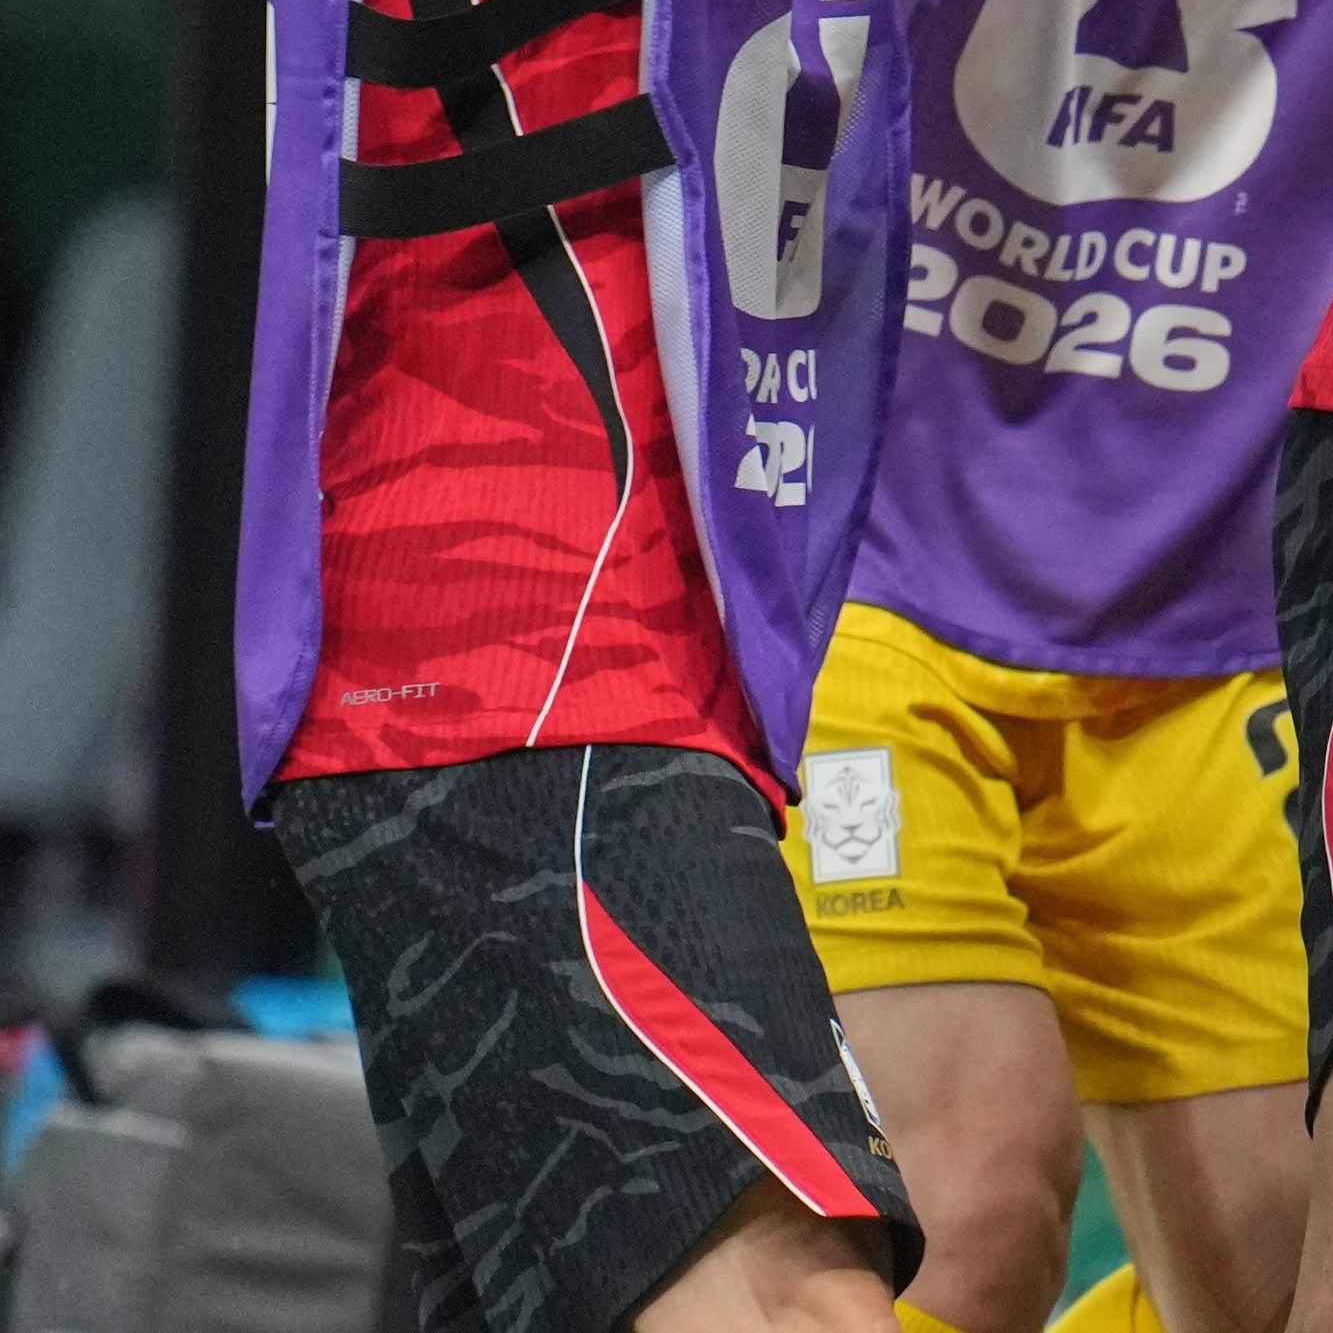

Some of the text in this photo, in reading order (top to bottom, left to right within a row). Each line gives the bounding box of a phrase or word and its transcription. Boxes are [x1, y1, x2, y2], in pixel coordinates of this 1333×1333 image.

[911, 174, 1107, 283] WORLD
[1113, 228, 1248, 295] CUP
[904, 244, 1234, 393] 2026
[340, 682, 441, 707] AERO-FIT
[816, 887, 905, 919] KOREA
